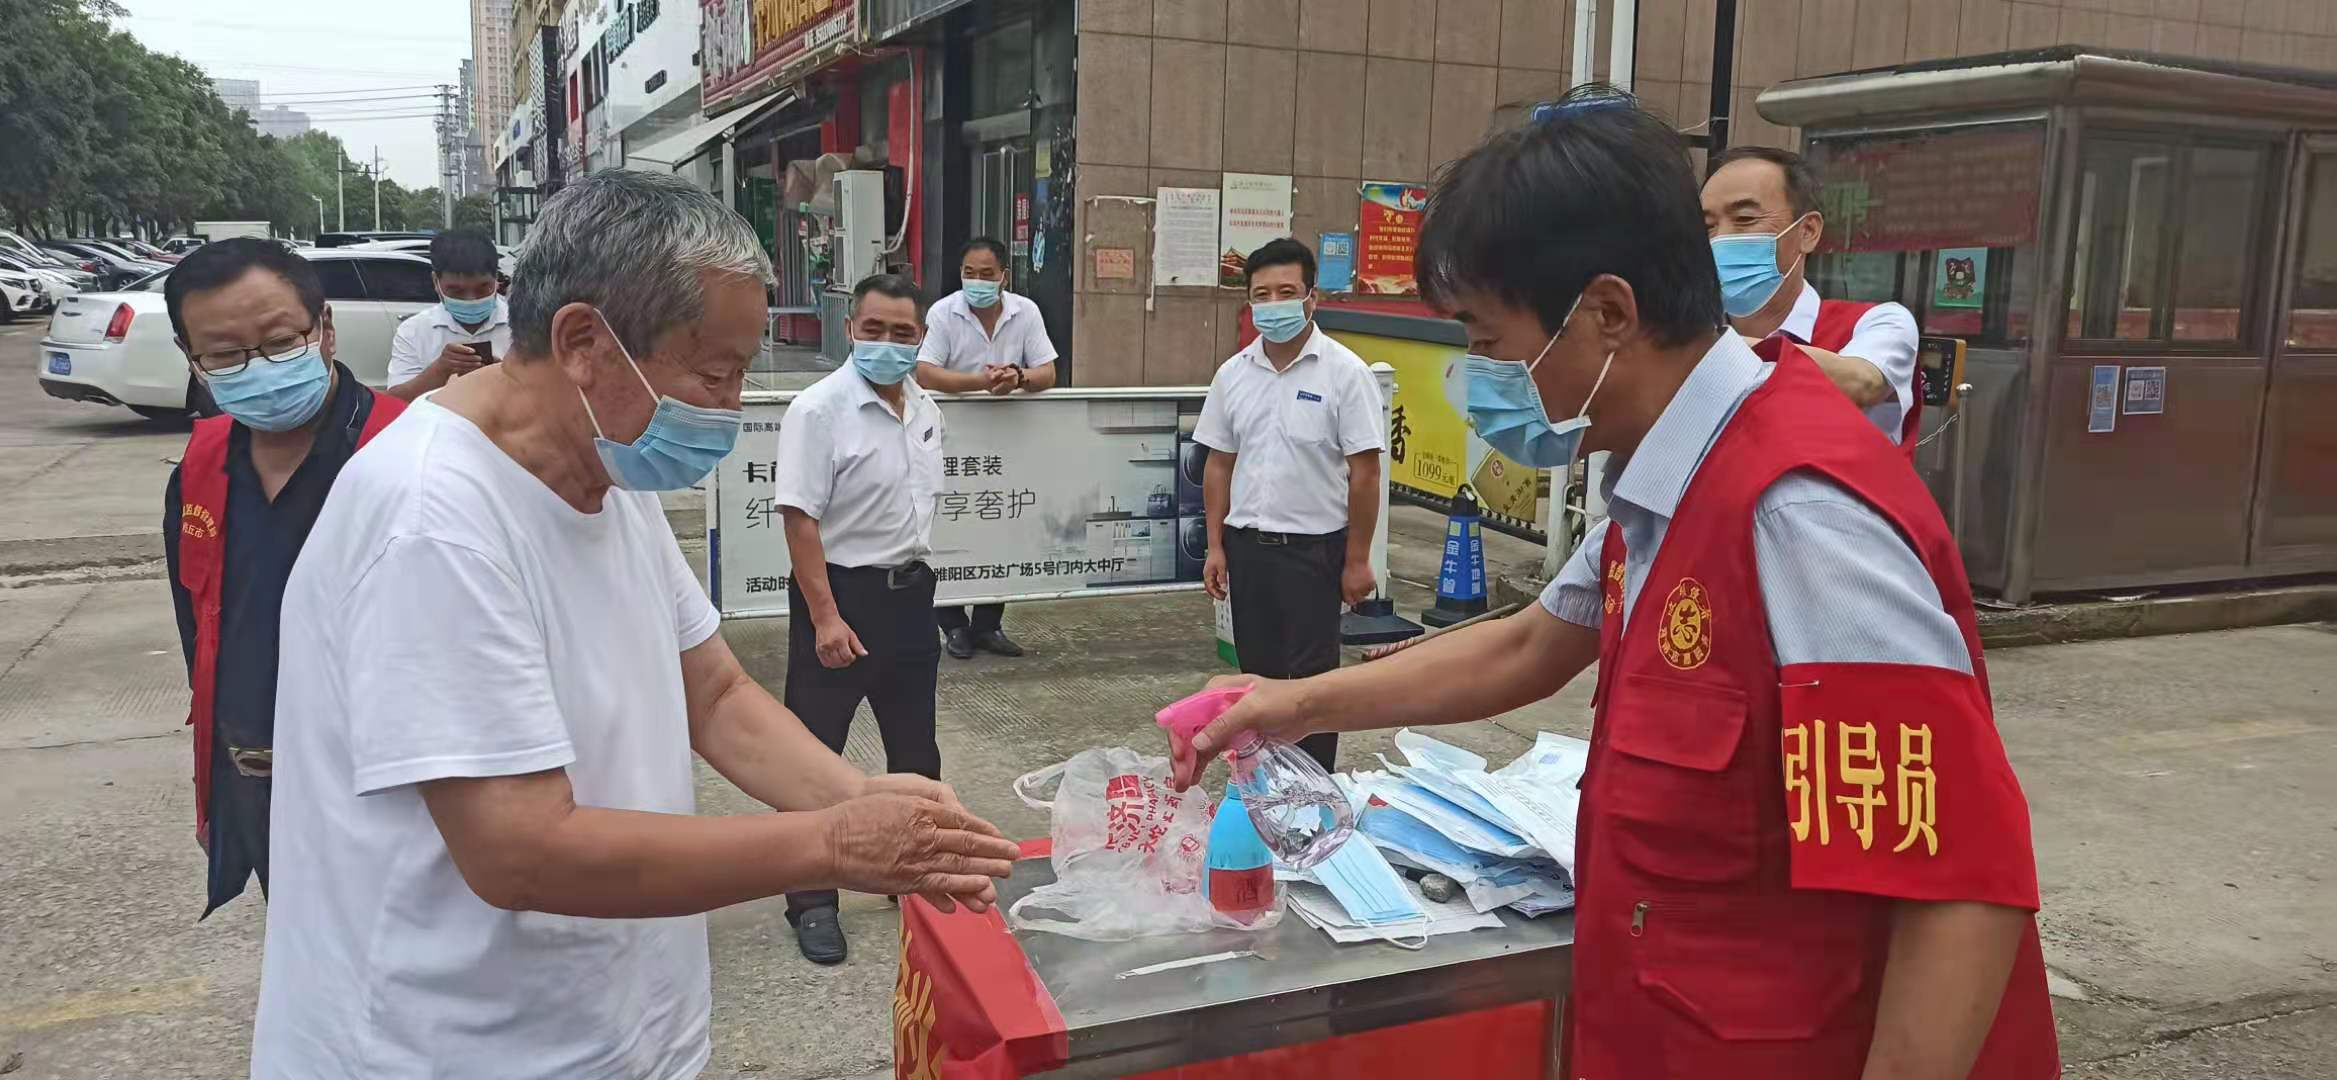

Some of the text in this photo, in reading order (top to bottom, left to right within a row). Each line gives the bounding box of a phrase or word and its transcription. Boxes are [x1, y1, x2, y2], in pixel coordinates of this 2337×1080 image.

[943, 455, 1002, 477] 理套装
[941, 488, 1036, 521] 享奢护
[1782, 719, 1938, 856] 引导员
